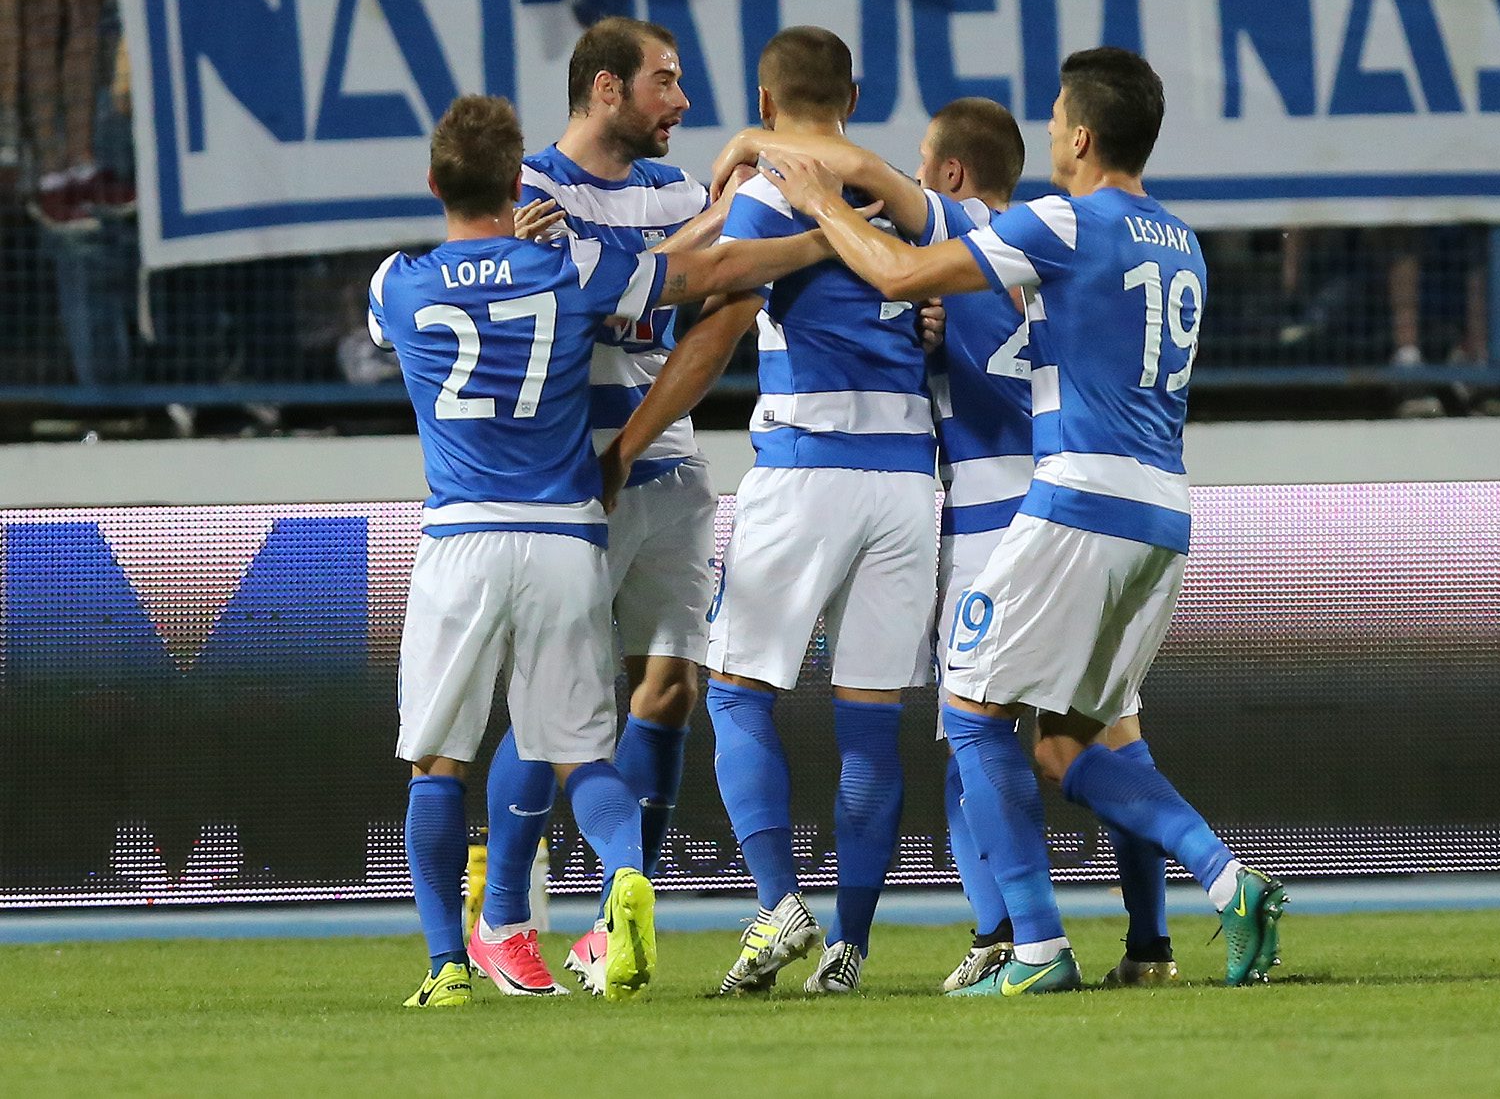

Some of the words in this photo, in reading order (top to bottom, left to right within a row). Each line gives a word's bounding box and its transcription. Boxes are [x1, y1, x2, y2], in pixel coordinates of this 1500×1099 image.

[1125, 216, 1191, 254] LESJAK
[441, 259, 513, 289] LOPA
[414, 291, 558, 420] 27
[1124, 261, 1202, 392] 19
[948, 589, 994, 653] 19
